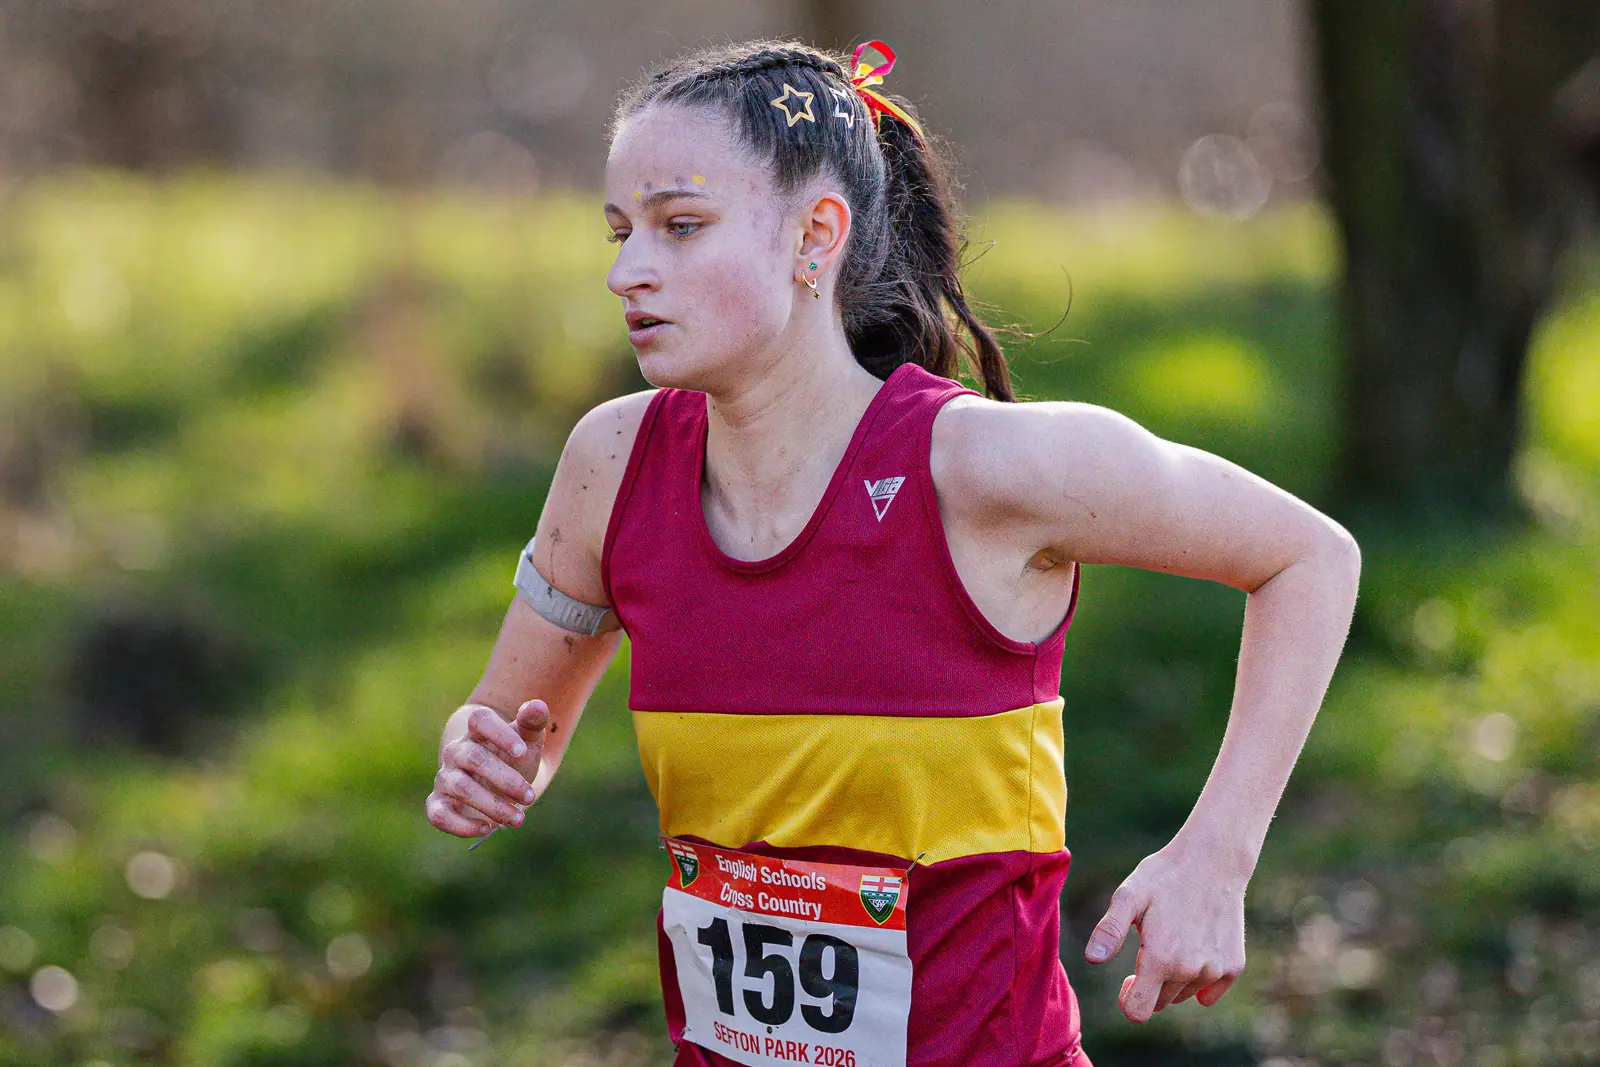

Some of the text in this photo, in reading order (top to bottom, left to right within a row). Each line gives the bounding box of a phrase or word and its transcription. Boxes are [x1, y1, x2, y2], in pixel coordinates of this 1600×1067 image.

[717, 854, 757, 882] English
[760, 866, 826, 891] Schools
[720, 883, 822, 921] Cross Country
[697, 916, 859, 1034] 159
[713, 1020, 856, 1067] SEFTON PARK 2026
